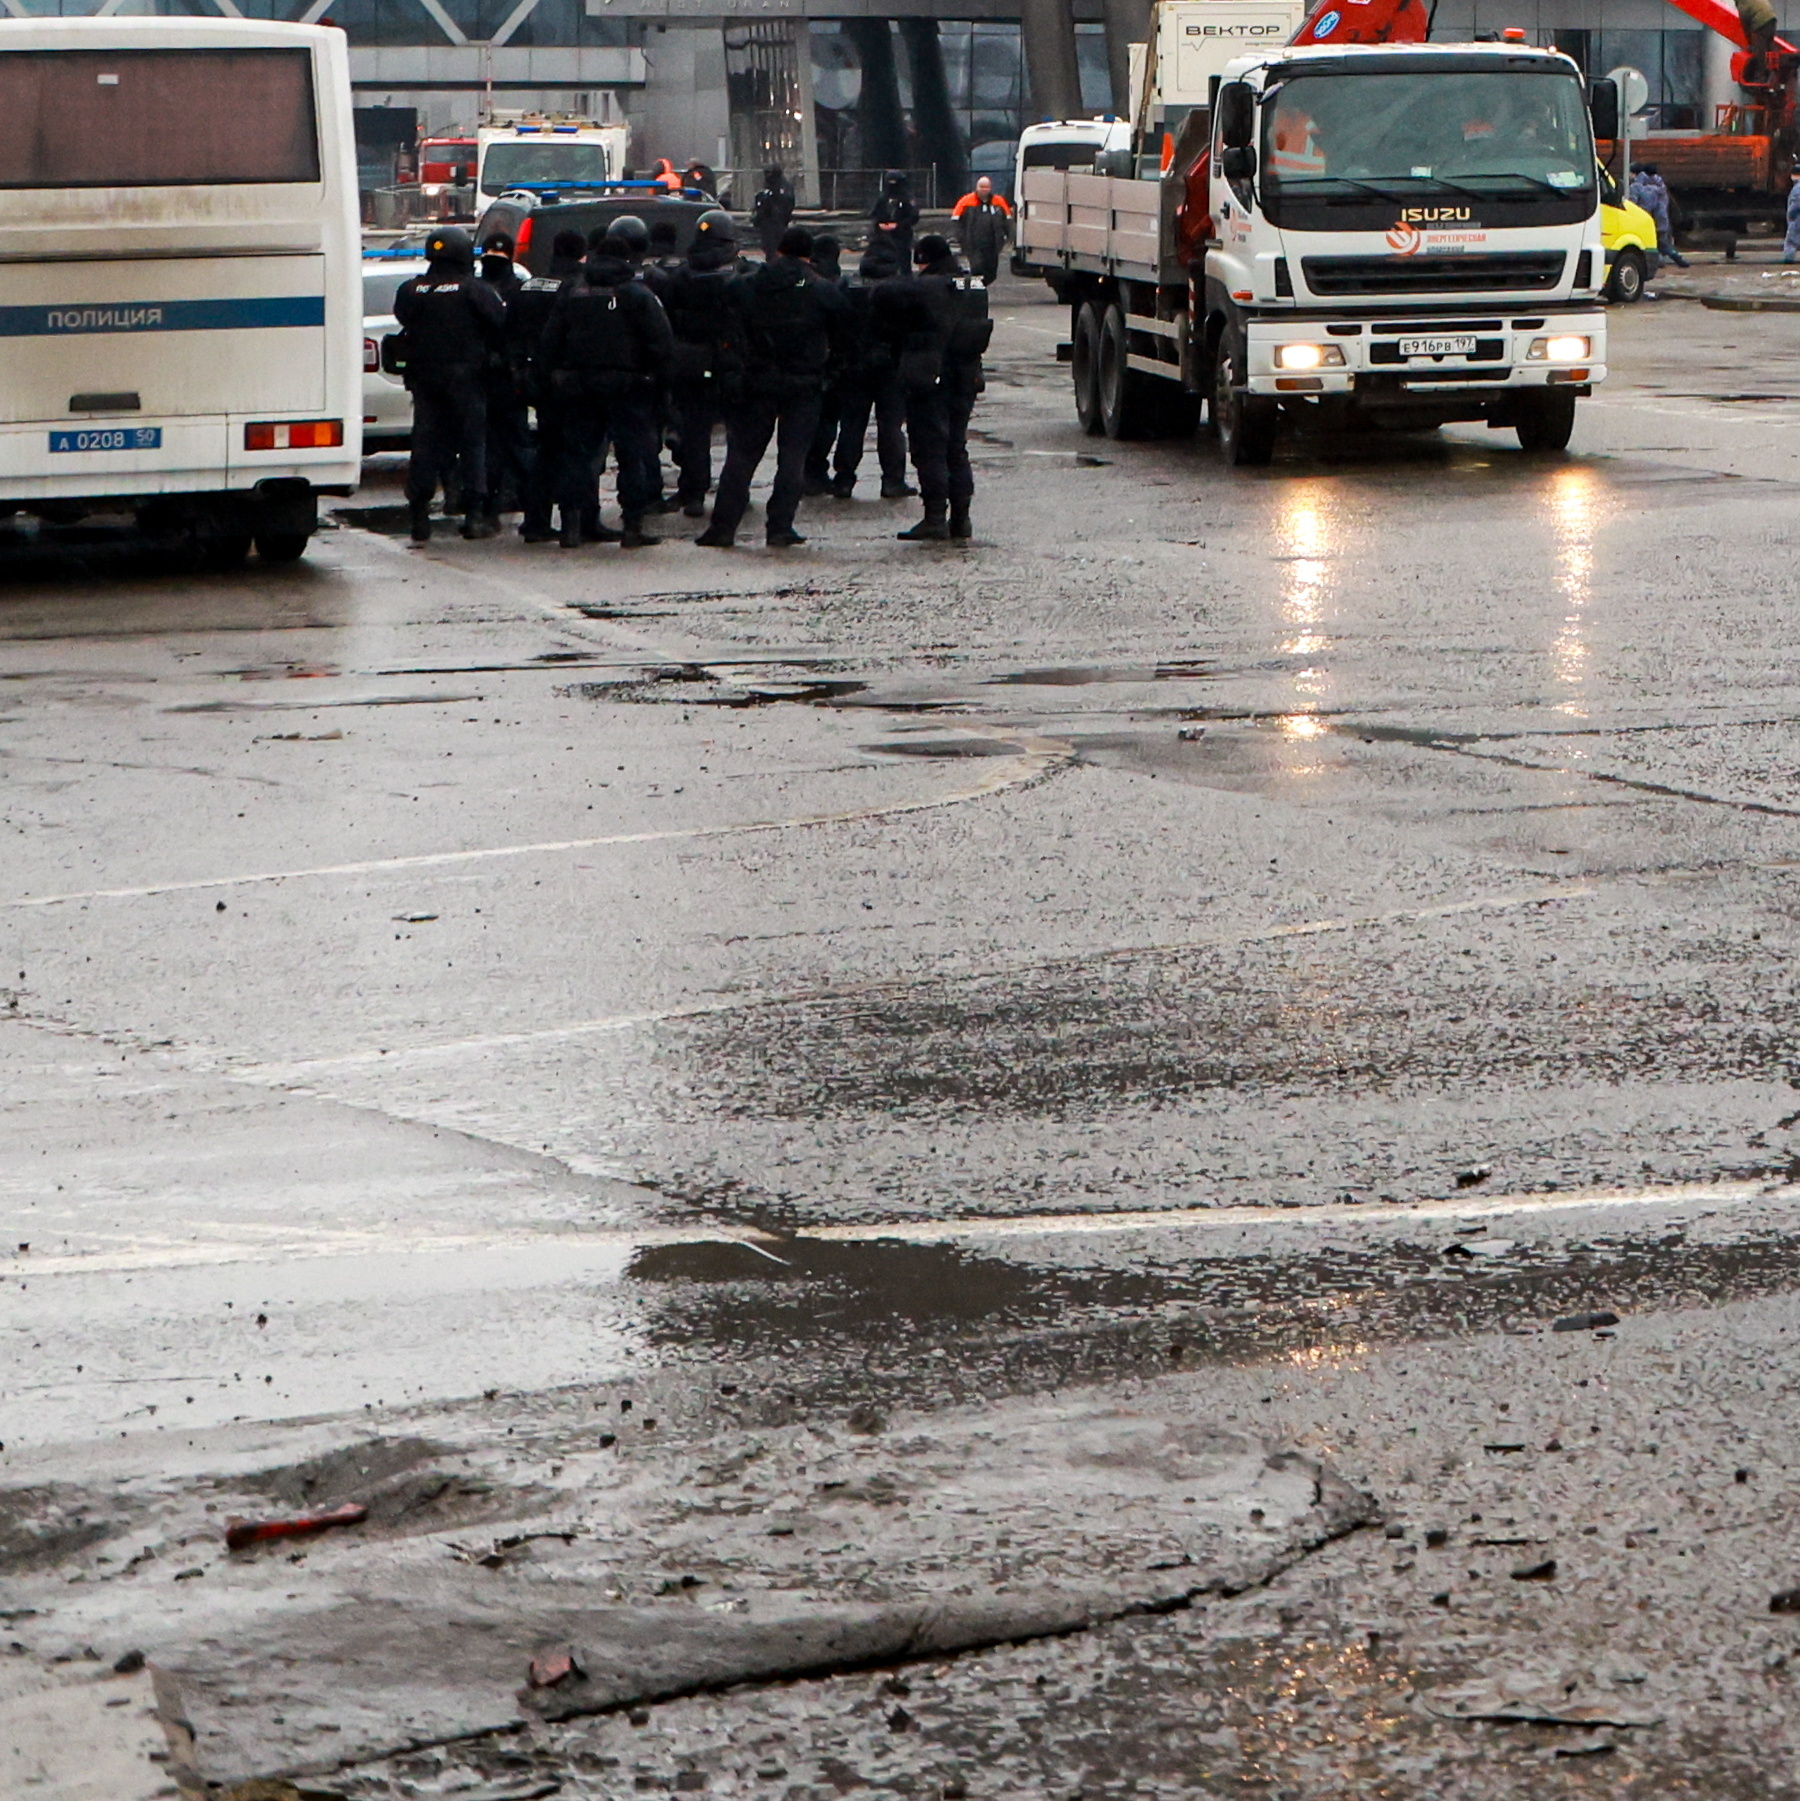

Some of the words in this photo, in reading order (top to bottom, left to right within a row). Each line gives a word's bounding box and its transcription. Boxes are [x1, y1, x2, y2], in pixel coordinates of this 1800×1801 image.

[1185, 25, 1280, 36] ВЕКТОР
[1401, 207, 1471, 222] ISUZU
[48, 309, 162, 328] ПОЛИЦИЯ
[77, 432, 125, 449] 0208
